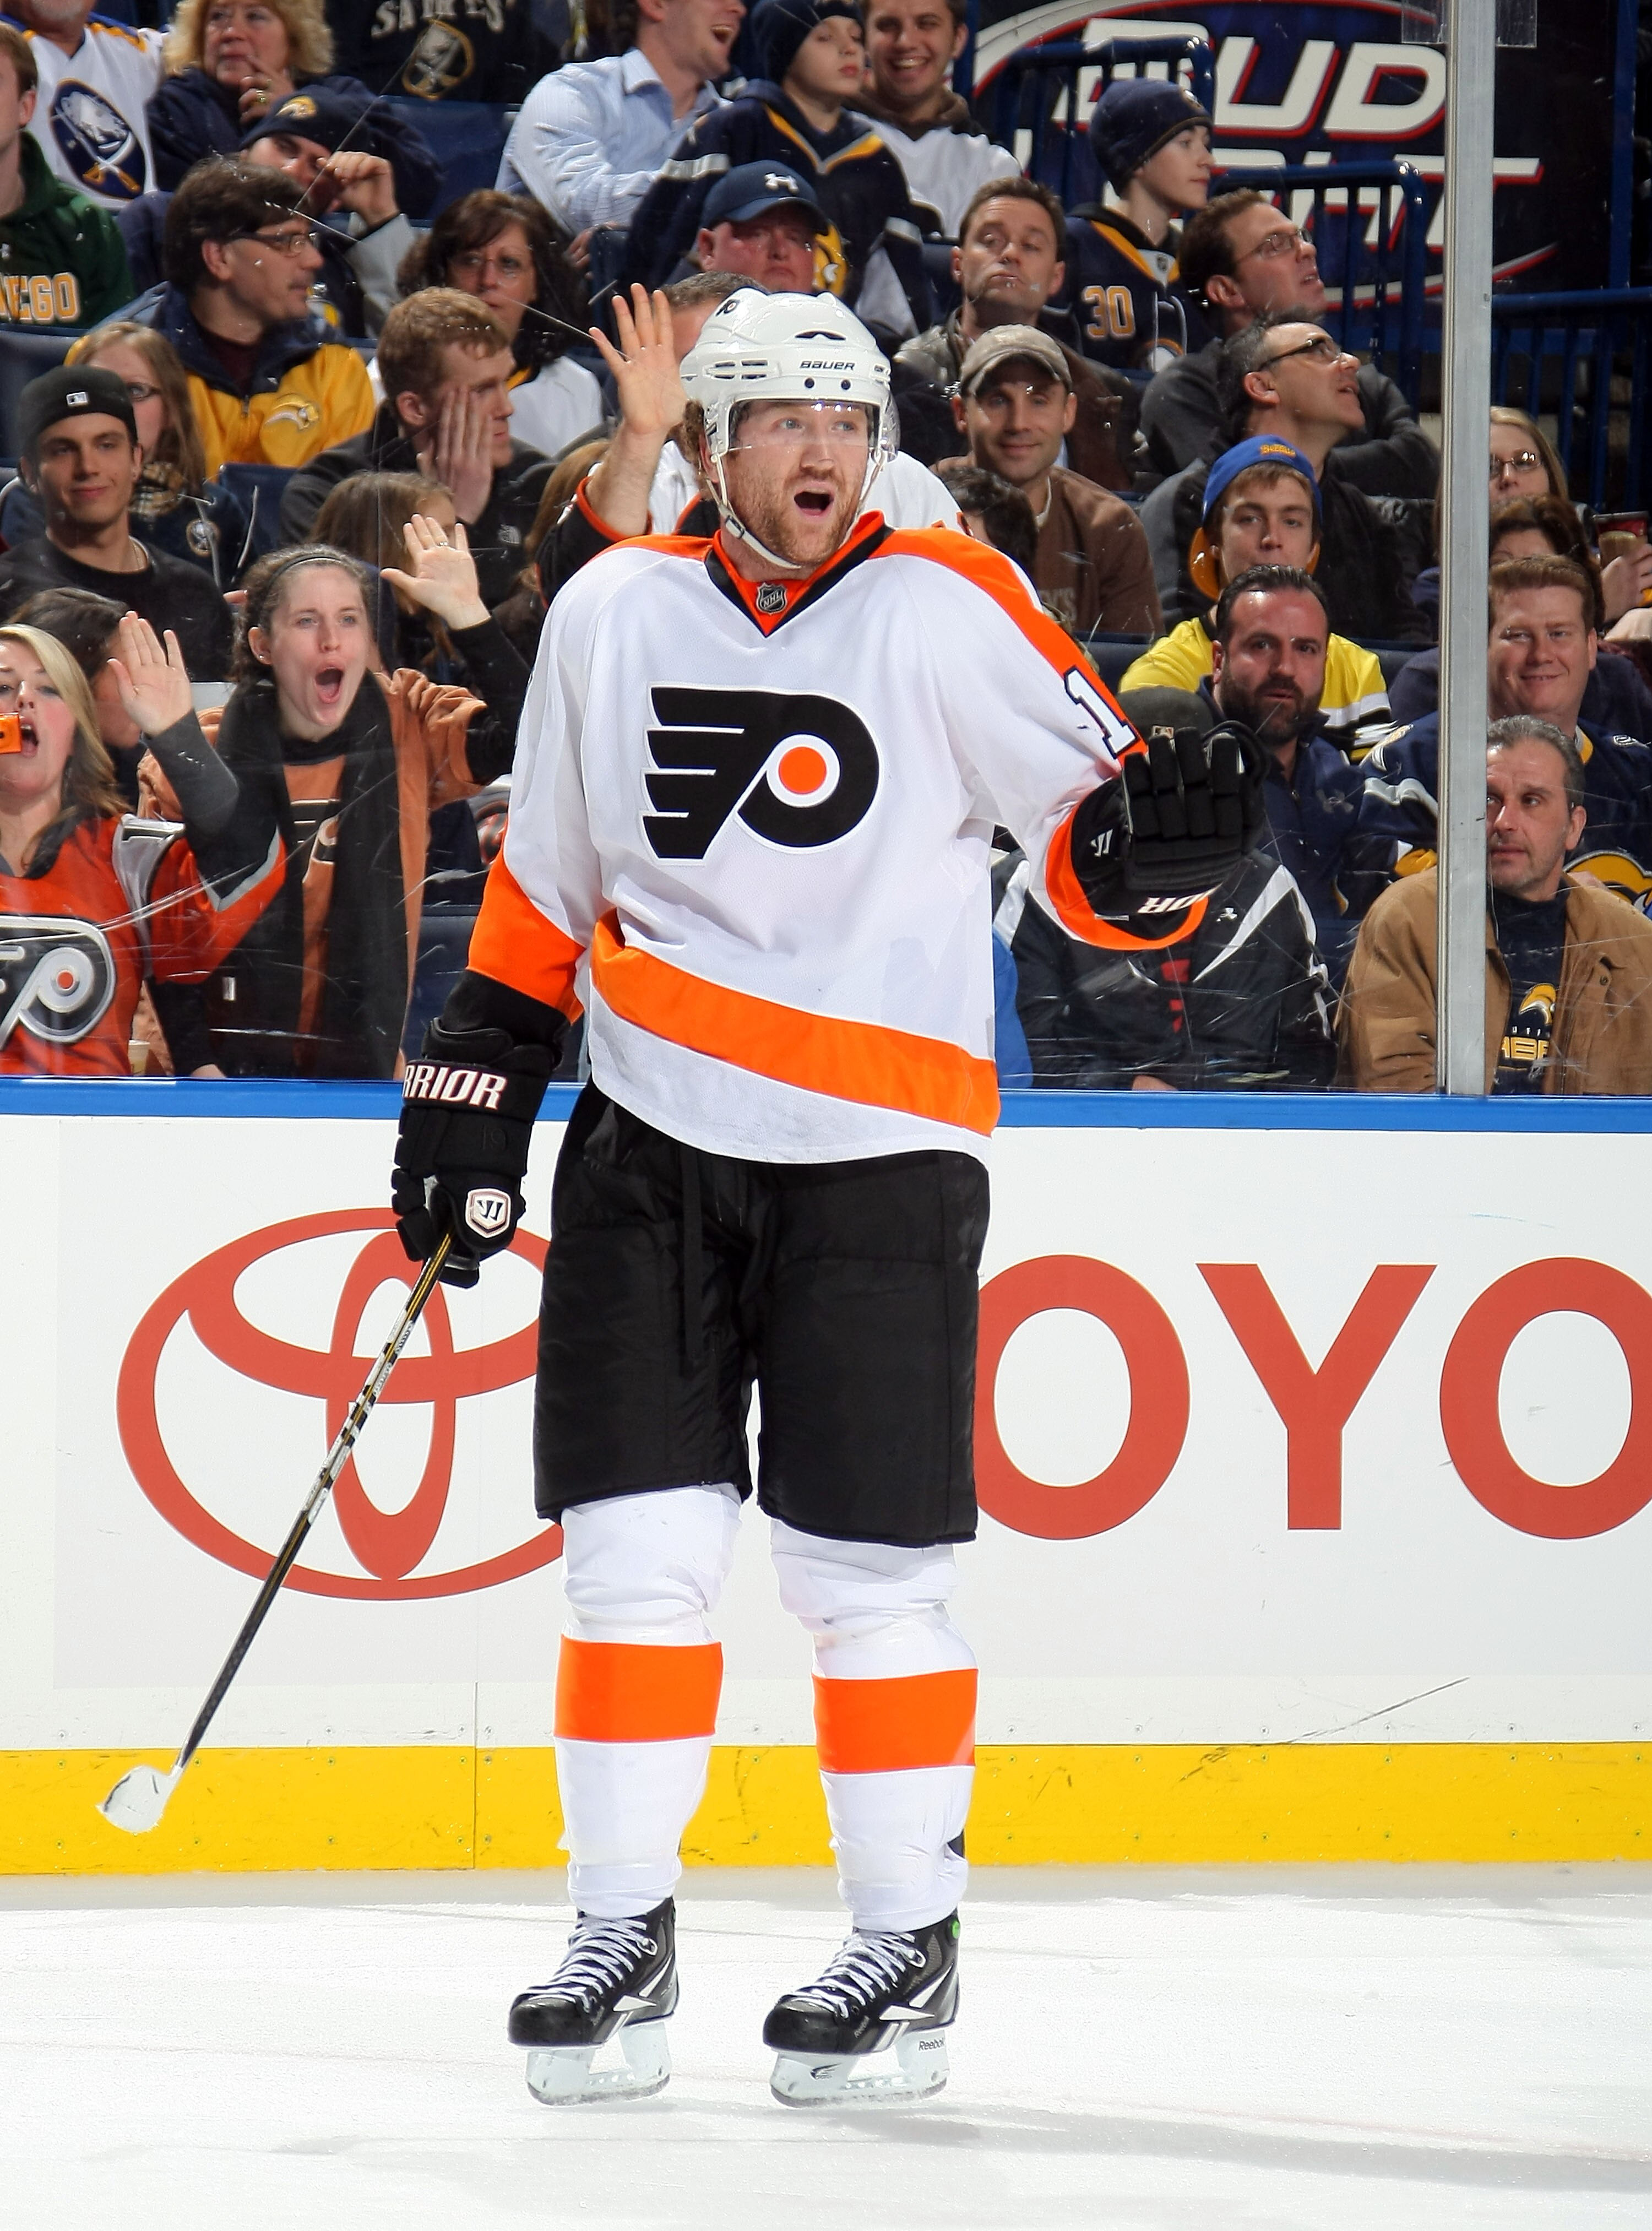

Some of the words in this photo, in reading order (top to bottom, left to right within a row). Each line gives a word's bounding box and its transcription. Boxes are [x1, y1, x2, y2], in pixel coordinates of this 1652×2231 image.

[0, 272, 81, 324] EGO
[1083, 285, 1135, 338] 30
[799, 360, 856, 371] BAUER
[763, 590, 783, 607] NHL
[974, 1254, 1652, 1541] OYO
